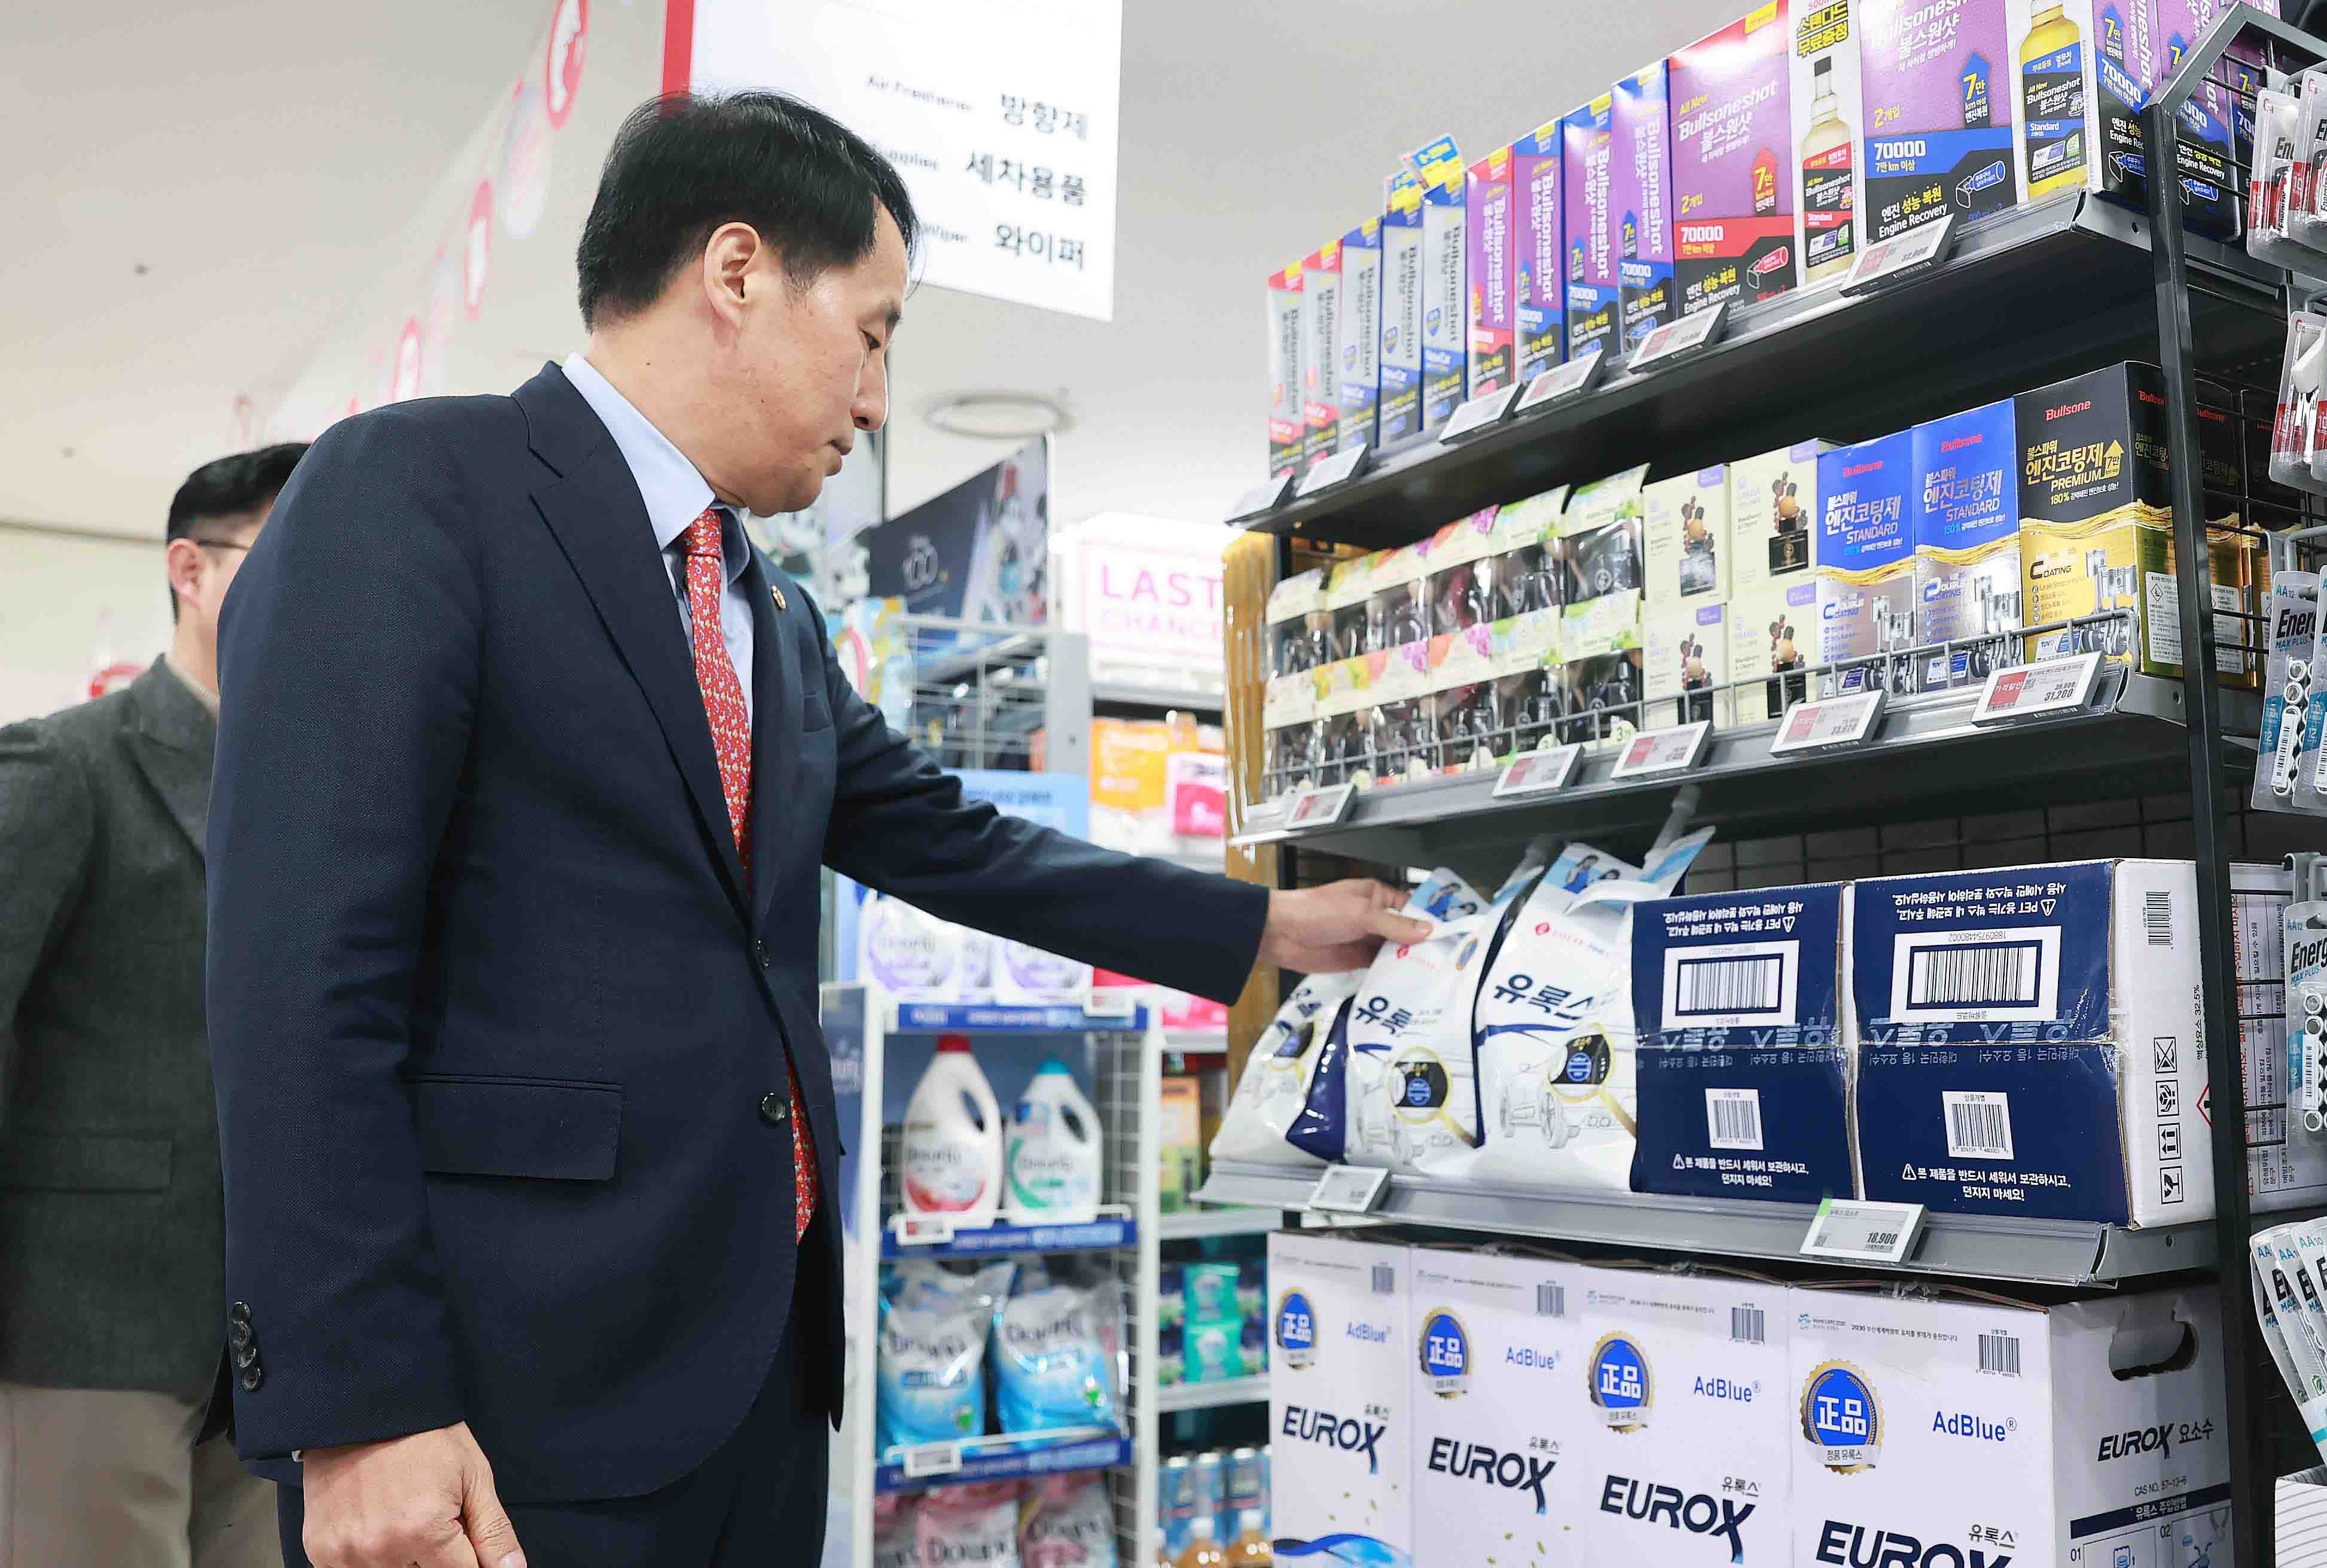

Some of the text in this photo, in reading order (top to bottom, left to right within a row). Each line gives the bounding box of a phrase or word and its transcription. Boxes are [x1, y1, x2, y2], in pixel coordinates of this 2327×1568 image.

[1797, 20, 1849, 57] 무료증정
[1963, 73, 1986, 100] 7만
[2102, 58, 2142, 103] 70000
[1001, 93, 1088, 141] 방향제
[2030, 122, 2060, 132] Standard
[2109, 130, 2132, 145] Engine
[1874, 140, 1926, 160] 70000
[1888, 161, 1899, 172] km
[2177, 153, 2198, 170] Engine
[2199, 163, 2225, 179] Recovery
[966, 151, 1085, 206] 세차용품
[1878, 219, 1907, 239] Engine
[1909, 203, 1948, 226] Recovery
[1881, 202, 1900, 223] 엔진
[1681, 225, 1724, 243] 70000
[994, 223, 1085, 269] 와이퍼
[2045, 401, 2091, 421] Bullsone
[2027, 440, 2058, 460] 불스파워
[2026, 441, 2105, 486] 엔진코팅제
[2051, 469, 2102, 492] PREMIUM
[1923, 469, 2003, 513] 엔진코팅제
[2050, 492, 2070, 505] 180%
[1825, 495, 1902, 536] 엔진코팅제
[1945, 498, 2000, 523] STANDARD
[1846, 522, 1898, 544] STANDARD
[2030, 561, 2072, 581] COATING
[1100, 563, 1224, 608] LAST
[2276, 636, 2307, 649] MAX PLUS
[2044, 688, 2073, 701] 31,200
[1986, 887, 2012, 899] 박스와
[2047, 882, 2066, 895] 사용
[1927, 907, 1953, 919] 보관해
[1968, 903, 1985, 916] 박스
[1988, 902, 2016, 915] 용기는
[2018, 901, 2038, 913] PET
[1764, 918, 1781, 929] PET
[2291, 967, 2320, 985] MAX PLUS
[1495, 974, 1593, 1020] 유록스
[2192, 985, 2201, 1016] 32.5%
[1869, 1053, 1898, 1066] 요소수!
[1979, 1050, 2012, 1062] 요소수!
[1718, 1158, 1740, 1171] 반드시
[1743, 1160, 1765, 1172] 세워서
[1768, 1161, 1809, 1175] 보관하시고,
[1746, 1175, 1773, 1186] 마세요!
[1917, 1168, 2072, 1188] 본 제품을 반드시 세워서 보관하시고,
[1963, 1186, 2025, 1201] 던지지 마세요!
[1867, 1232, 1898, 1244] 18,900
[1282, 1312, 1313, 1342] 正品
[1428, 1337, 1463, 1368] 正品
[1601, 1363, 1642, 1399] 正品
[1817, 1395, 1867, 1436] 正品
[1282, 1405, 1386, 1475] EUROX
[2097, 1418, 2215, 1462] EUROX 요소수
[1429, 1436, 1557, 1515] EUROX
[1722, 1476, 1760, 1497] 유록스
[2135, 1482, 2147, 1496] CAS
[2148, 1481, 2160, 1494] NO.
[1601, 1474, 1756, 1564] EUROX
[1968, 1524, 2017, 1549] 유록스
[2160, 1524, 2171, 1538] 02
[1816, 1520, 2014, 1568] EURO
[2070, 1548, 2081, 1561] 01
